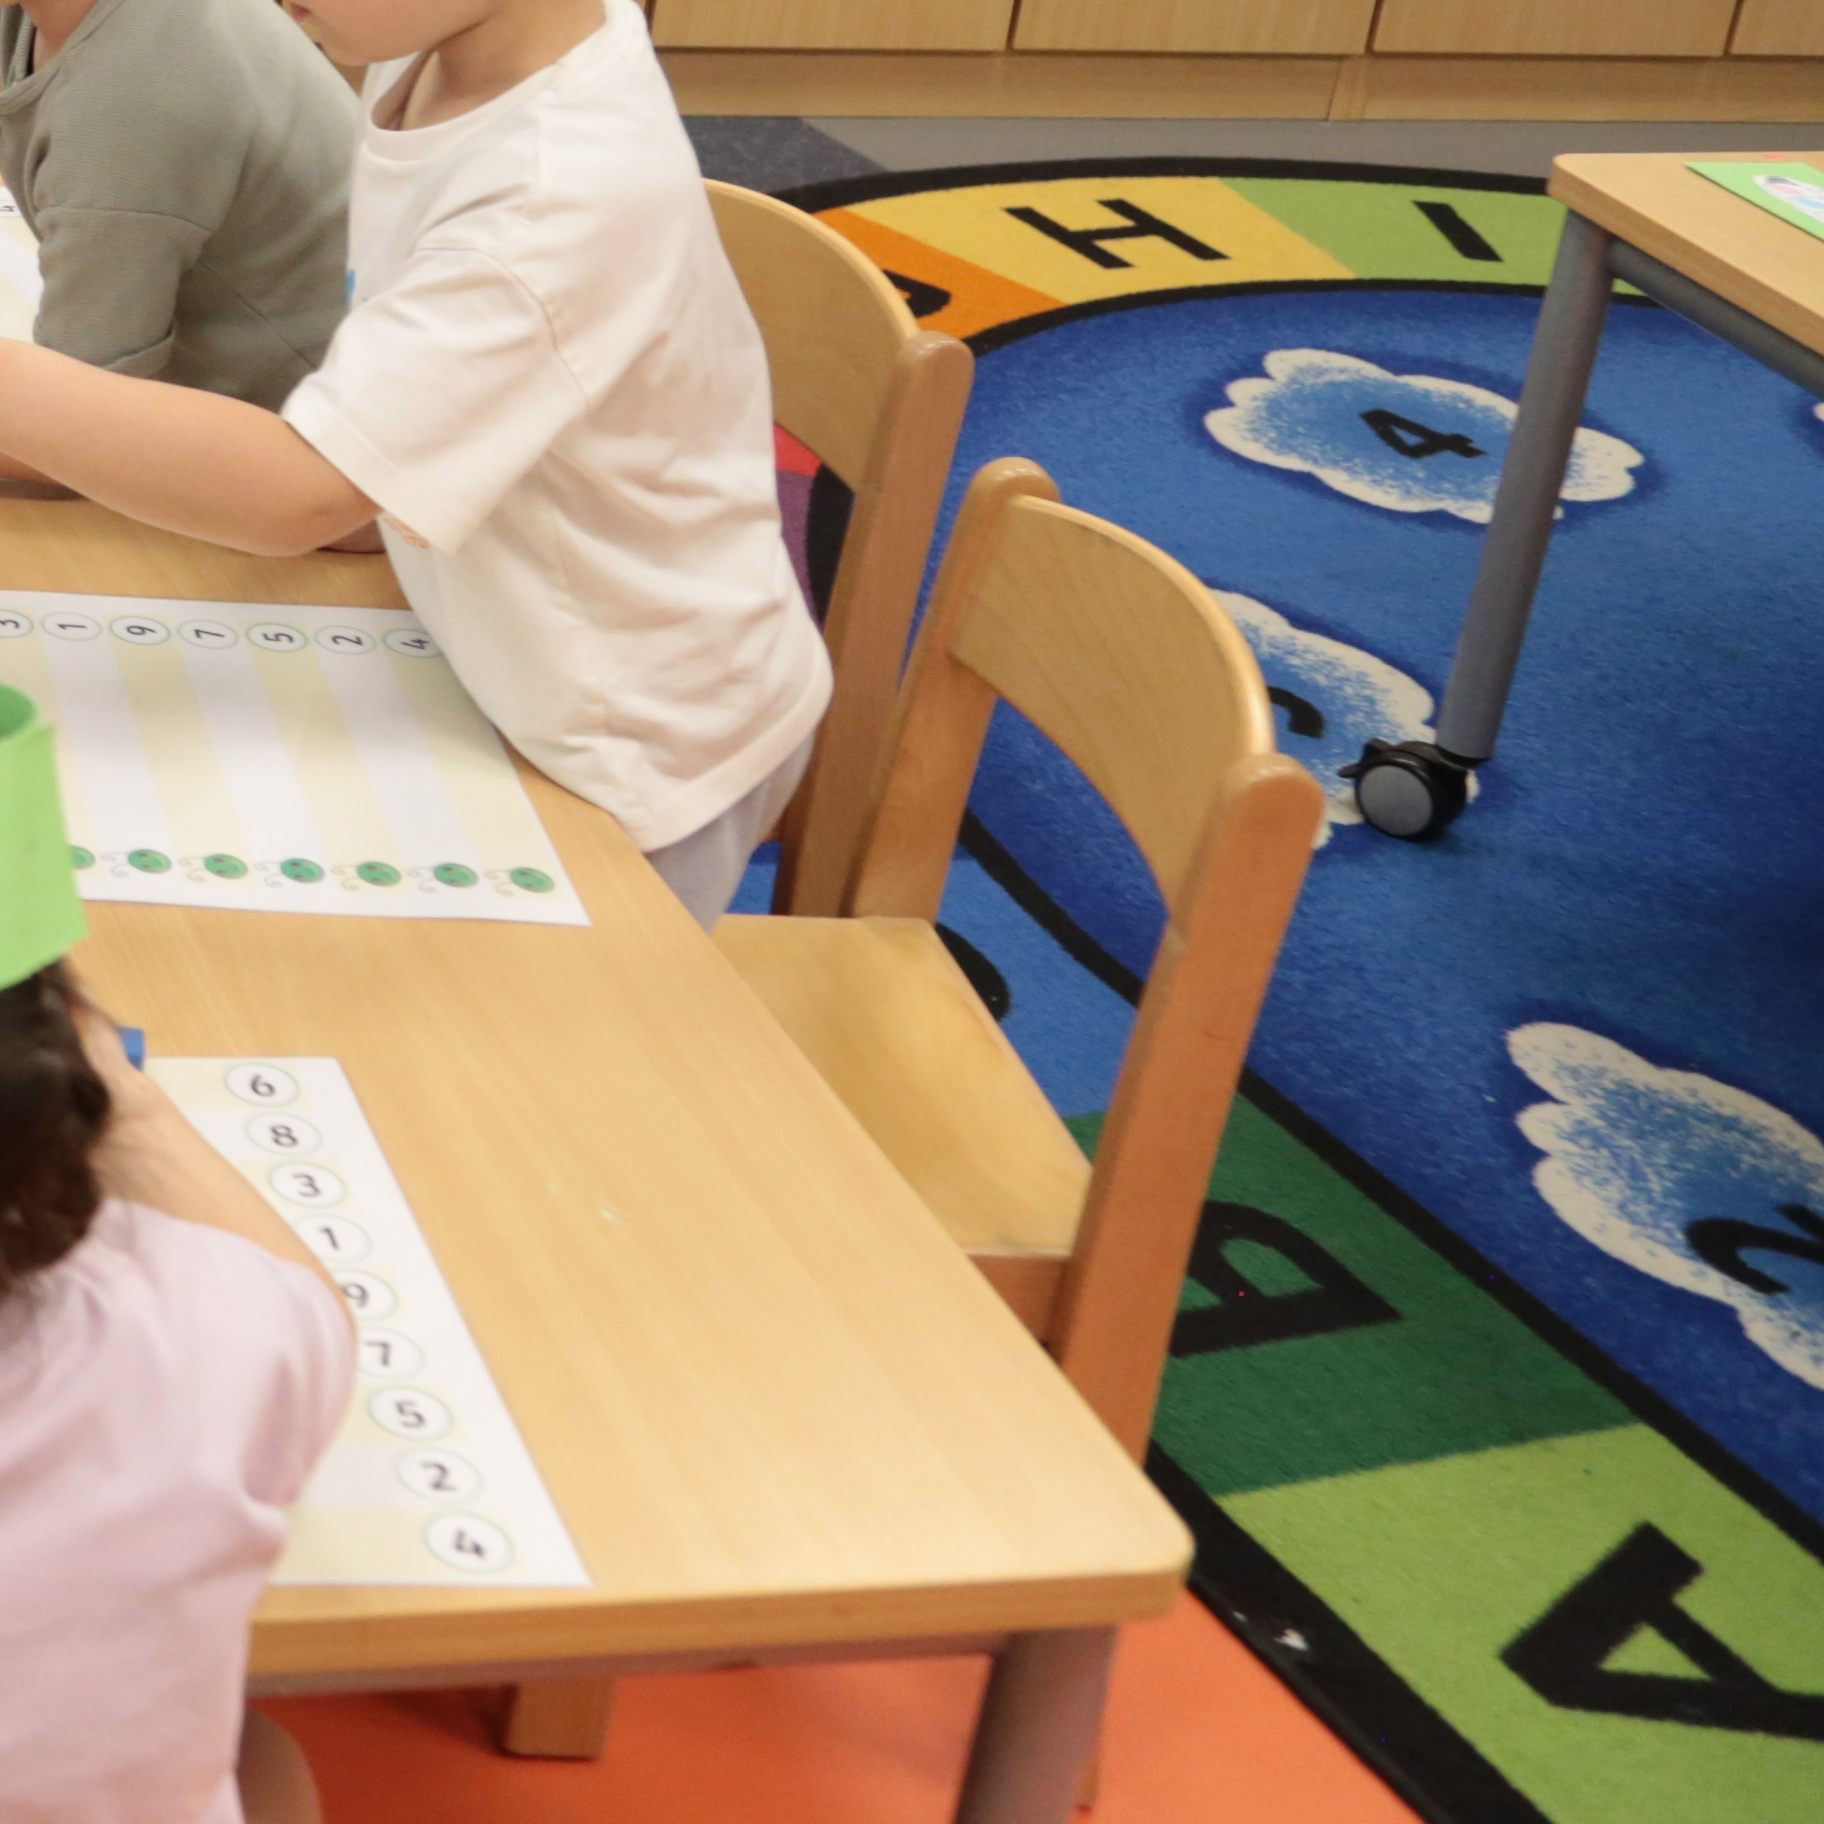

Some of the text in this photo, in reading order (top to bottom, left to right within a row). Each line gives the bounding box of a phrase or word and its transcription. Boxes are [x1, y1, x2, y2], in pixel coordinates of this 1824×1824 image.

[1004, 197, 1229, 270] H
[1356, 407, 1485, 461] 4
[59, 622, 88, 630] 1
[194, 628, 225, 639] 7
[263, 632, 294, 643] 5
[332, 635, 362, 645] 2
[400, 637, 436, 650] 4
[250, 1075, 275, 1096] 6
[270, 1125, 298, 1146] 8
[294, 1173, 321, 1197] 3
[321, 1226, 339, 1250] 1
[343, 1283, 369, 1308] 9
[367, 1341, 391, 1367] 7
[395, 1401, 426, 1428] 5
[423, 1462, 457, 1492] 2
[454, 1531, 484, 1557] 4
